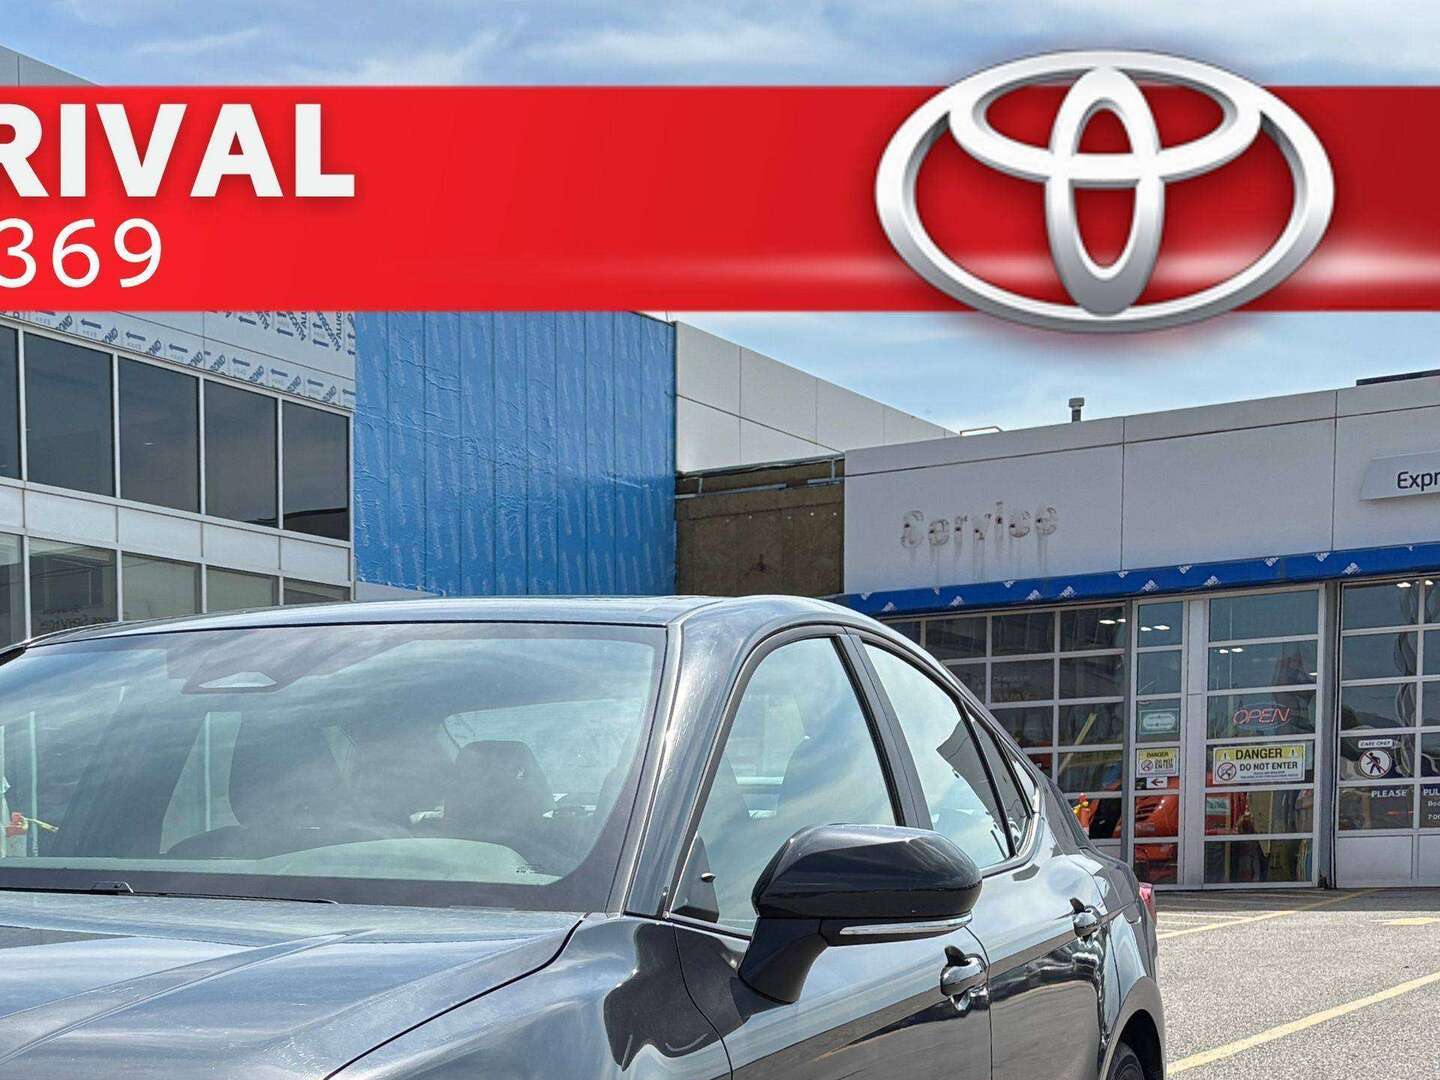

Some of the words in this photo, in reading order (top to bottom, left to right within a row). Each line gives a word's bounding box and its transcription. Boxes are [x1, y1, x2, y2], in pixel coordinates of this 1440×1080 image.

[1232, 706, 1292, 726] OPEN
[1235, 748, 1282, 760] DANGER
[1239, 763, 1251, 771] DO
[1253, 762, 1270, 770] NOT
[1272, 761, 1298, 770] ENTER
[1371, 789, 1408, 798] PLEASE
